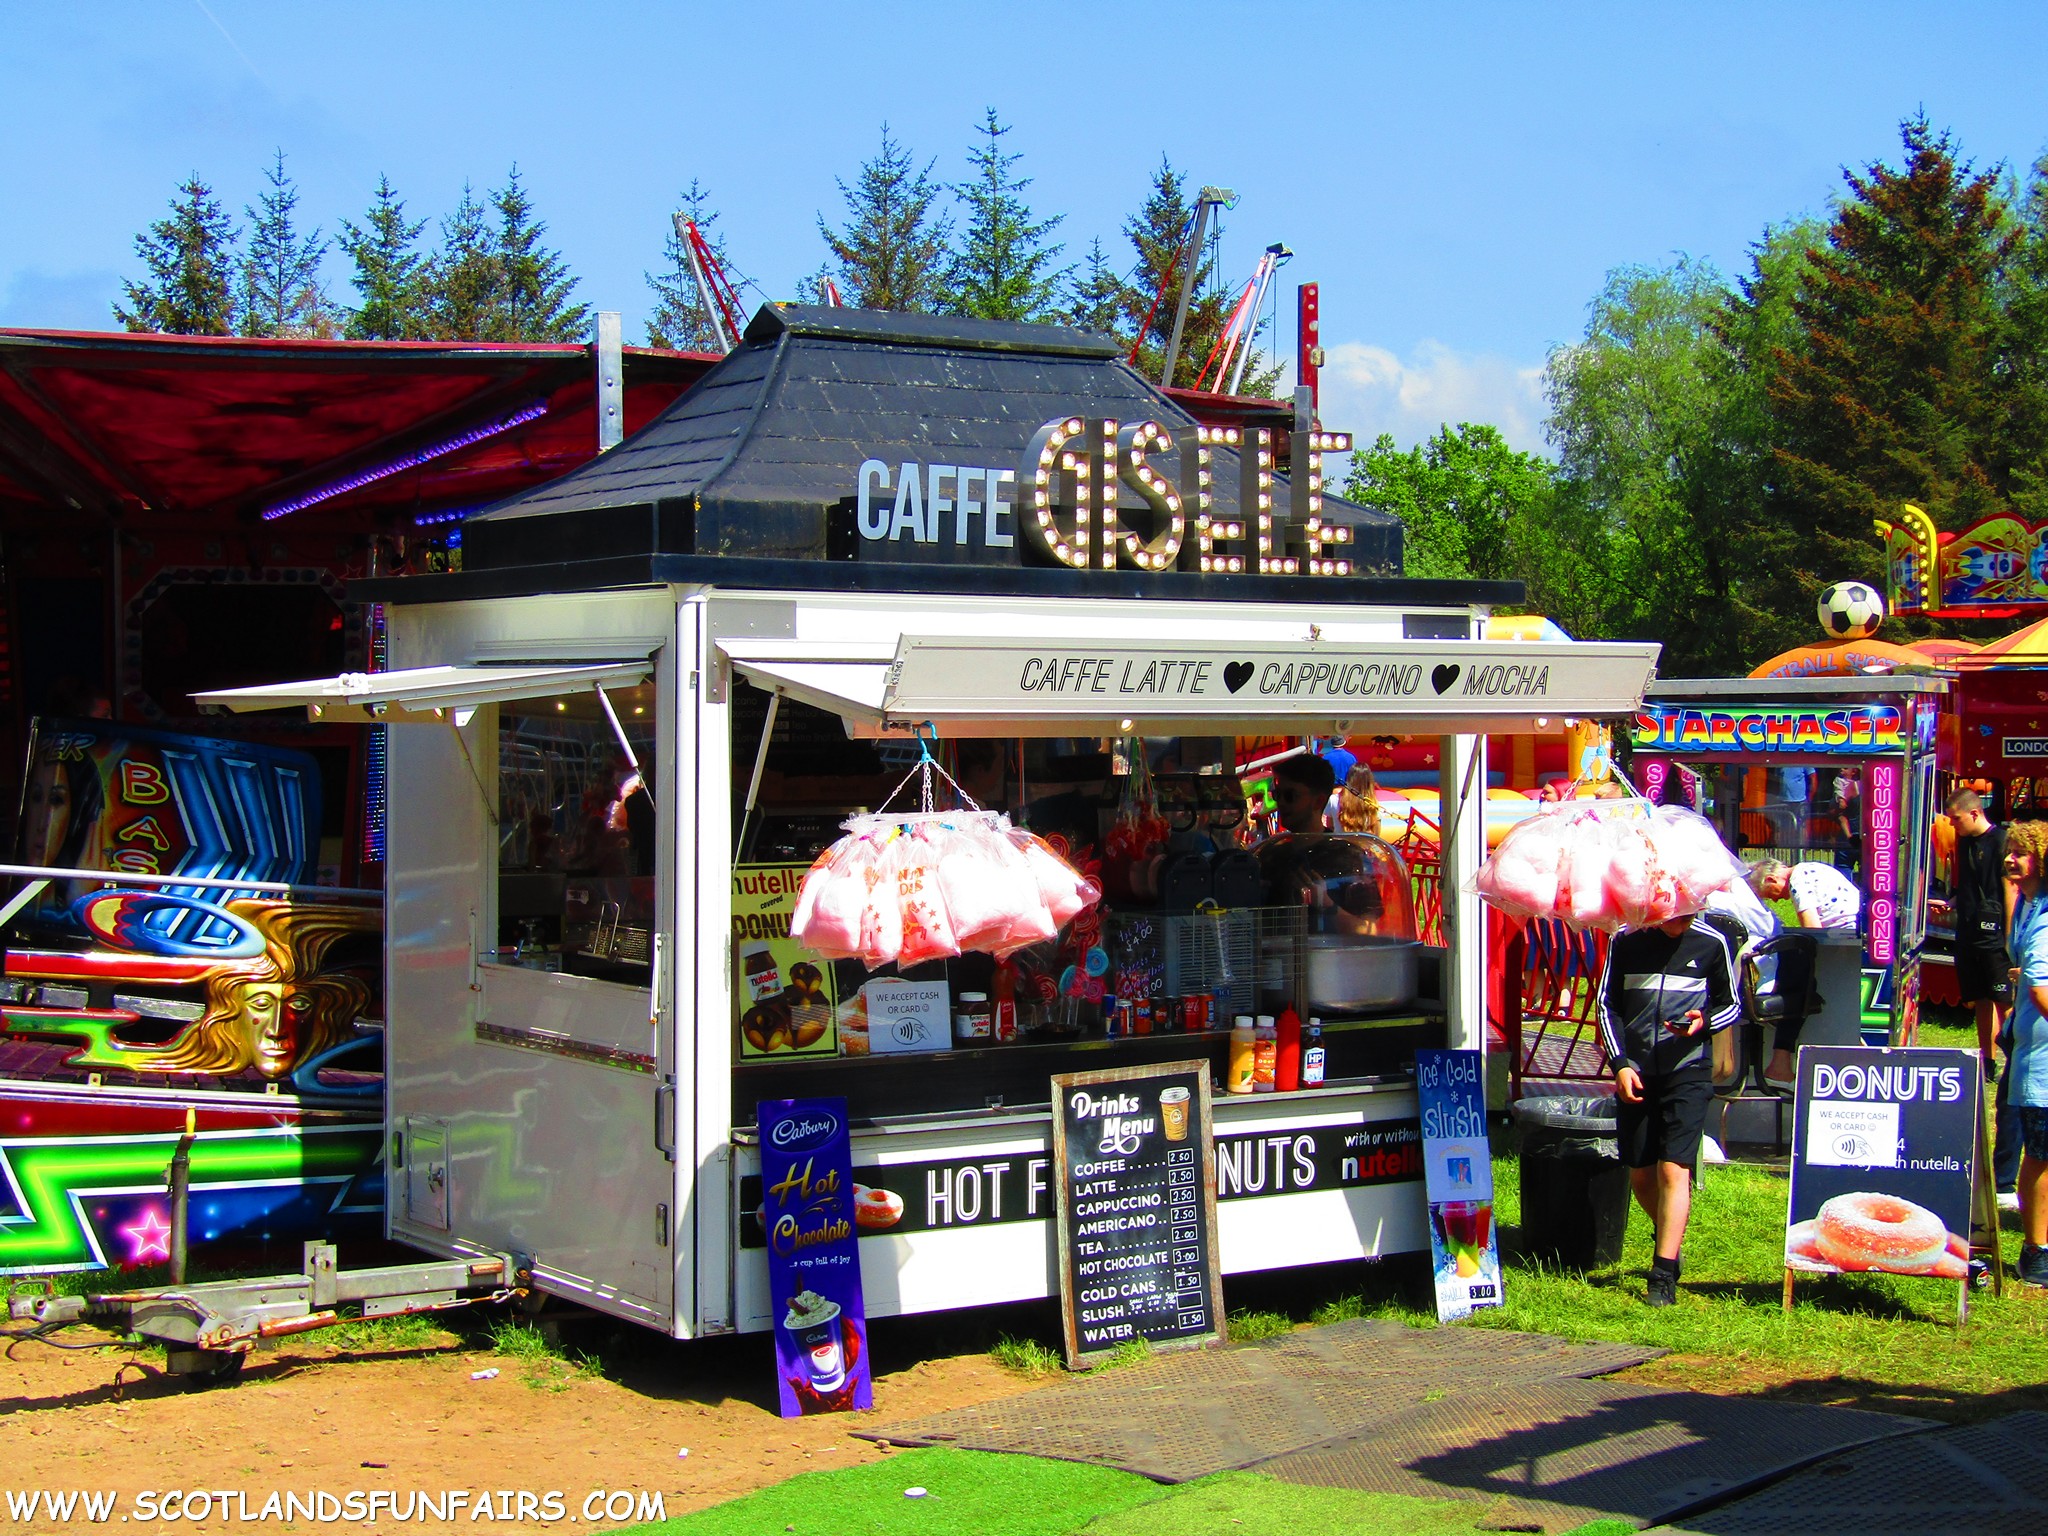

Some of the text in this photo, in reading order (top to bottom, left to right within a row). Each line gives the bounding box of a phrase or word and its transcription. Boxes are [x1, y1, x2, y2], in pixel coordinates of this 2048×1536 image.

[857, 416, 1353, 576] CAFFE GISELE
[1020, 658, 1549, 695] CAFFE LATTE CAPPUCCINO MOCHA
[1767, 654, 1838, 678] TBALL
[1636, 707, 1902, 748] STARCHASER
[1871, 766, 1893, 961] NUMBER ONE
[760, 895, 784, 909] covered
[732, 913, 793, 939] DONU
[751, 971, 779, 987] nutella
[876, 991, 940, 1002] WE ACCEPT CASH
[888, 1004, 921, 1014] OR CARD
[1309, 1053, 1322, 1063] HP
[1419, 1056, 1477, 1088] Ice Cold
[1813, 1064, 1961, 1101] DONUTS
[1070, 1091, 1140, 1120] Drinks
[1424, 1094, 1483, 1138] Slush
[1820, 1111, 1888, 1121] WE ACCEPT CASH
[772, 1117, 832, 1145] Cadbury
[1098, 1116, 1155, 1155] Menu
[1344, 1127, 1421, 1147] with or withou
[1830, 1122, 1867, 1131] OR CARD
[1074, 1152, 1190, 1177] COFFEE 2.50
[1910, 1156, 1960, 1171] nutella
[769, 1156, 840, 1208] Hot
[927, 1163, 1010, 1226] HOT
[1213, 1135, 1316, 1195] NUTS
[1075, 1171, 1192, 1197] LATTE 2.50
[1076, 1190, 1193, 1216] CAPPUCCINO 2.50
[773, 1214, 851, 1254] Chocolate
[1078, 1209, 1195, 1235] AMERICANO 2.50
[1078, 1229, 1195, 1255] TEA 2.00
[800, 1260, 813, 1268] cup
[815, 1256, 828, 1265] full
[830, 1256, 838, 1264] of
[1079, 1260, 1102, 1275] HOT
[1104, 1252, 1168, 1271] CHOCOLATE
[1081, 1285, 1118, 1303] COLD
[1120, 1280, 1156, 1296] CANS
[1178, 1276, 1198, 1287] 1.50
[1471, 1286, 1492, 1298] 3.00
[1082, 1304, 1125, 1323] SLUSH
[1084, 1313, 1202, 1342] WATER 1.50
